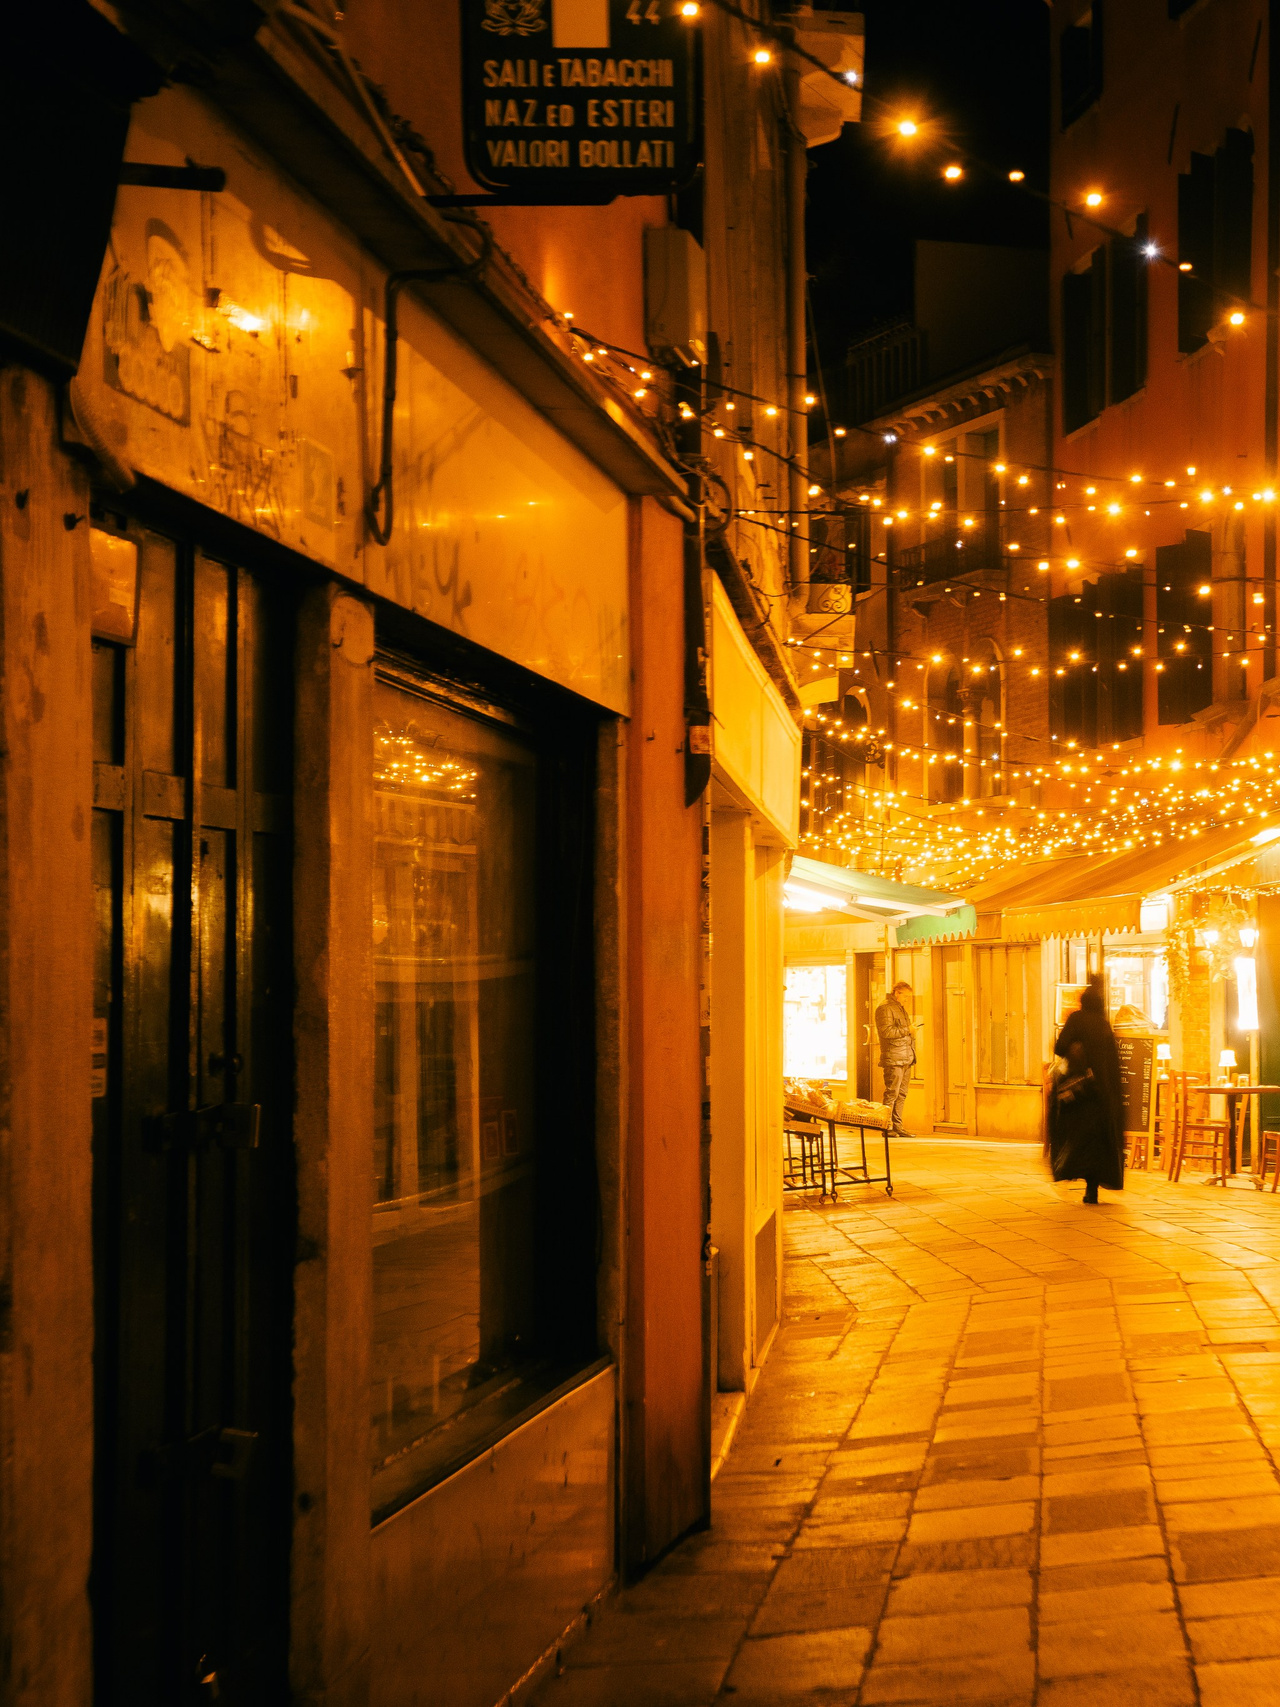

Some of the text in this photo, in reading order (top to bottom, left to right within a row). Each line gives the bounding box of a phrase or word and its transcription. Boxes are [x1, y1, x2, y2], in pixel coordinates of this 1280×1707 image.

[483, 58, 538, 87] SALI
[557, 58, 674, 87] TABACCHI
[587, 99, 675, 128] ESTERI
[486, 139, 675, 168] VALORI BOLLATI
